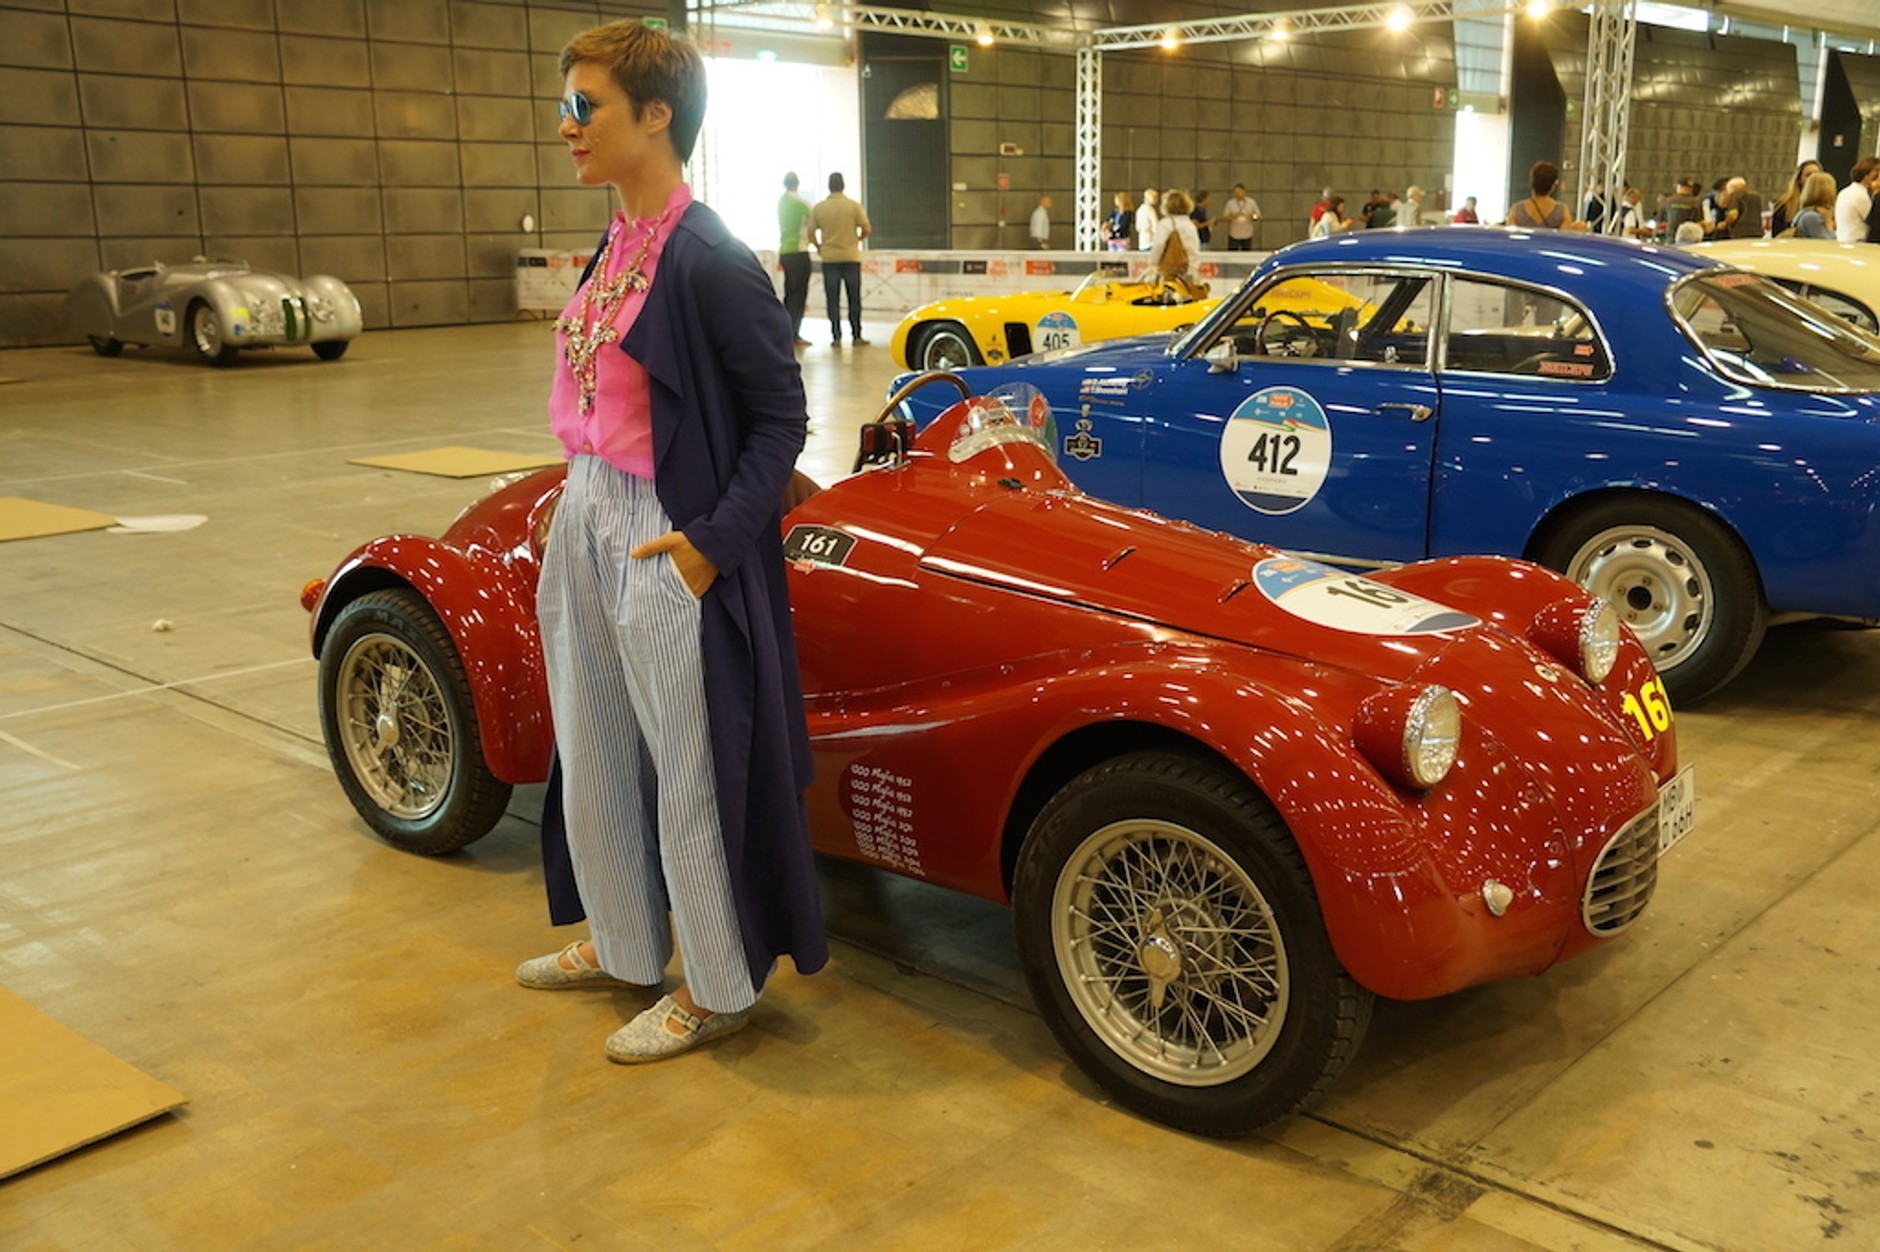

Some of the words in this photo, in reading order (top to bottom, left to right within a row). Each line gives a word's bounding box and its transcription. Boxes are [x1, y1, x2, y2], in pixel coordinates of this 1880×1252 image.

[1042, 333, 1070, 351] 405
[1248, 433, 1301, 476] 412
[801, 533, 838, 556] 161
[1622, 675, 1674, 741] 161
